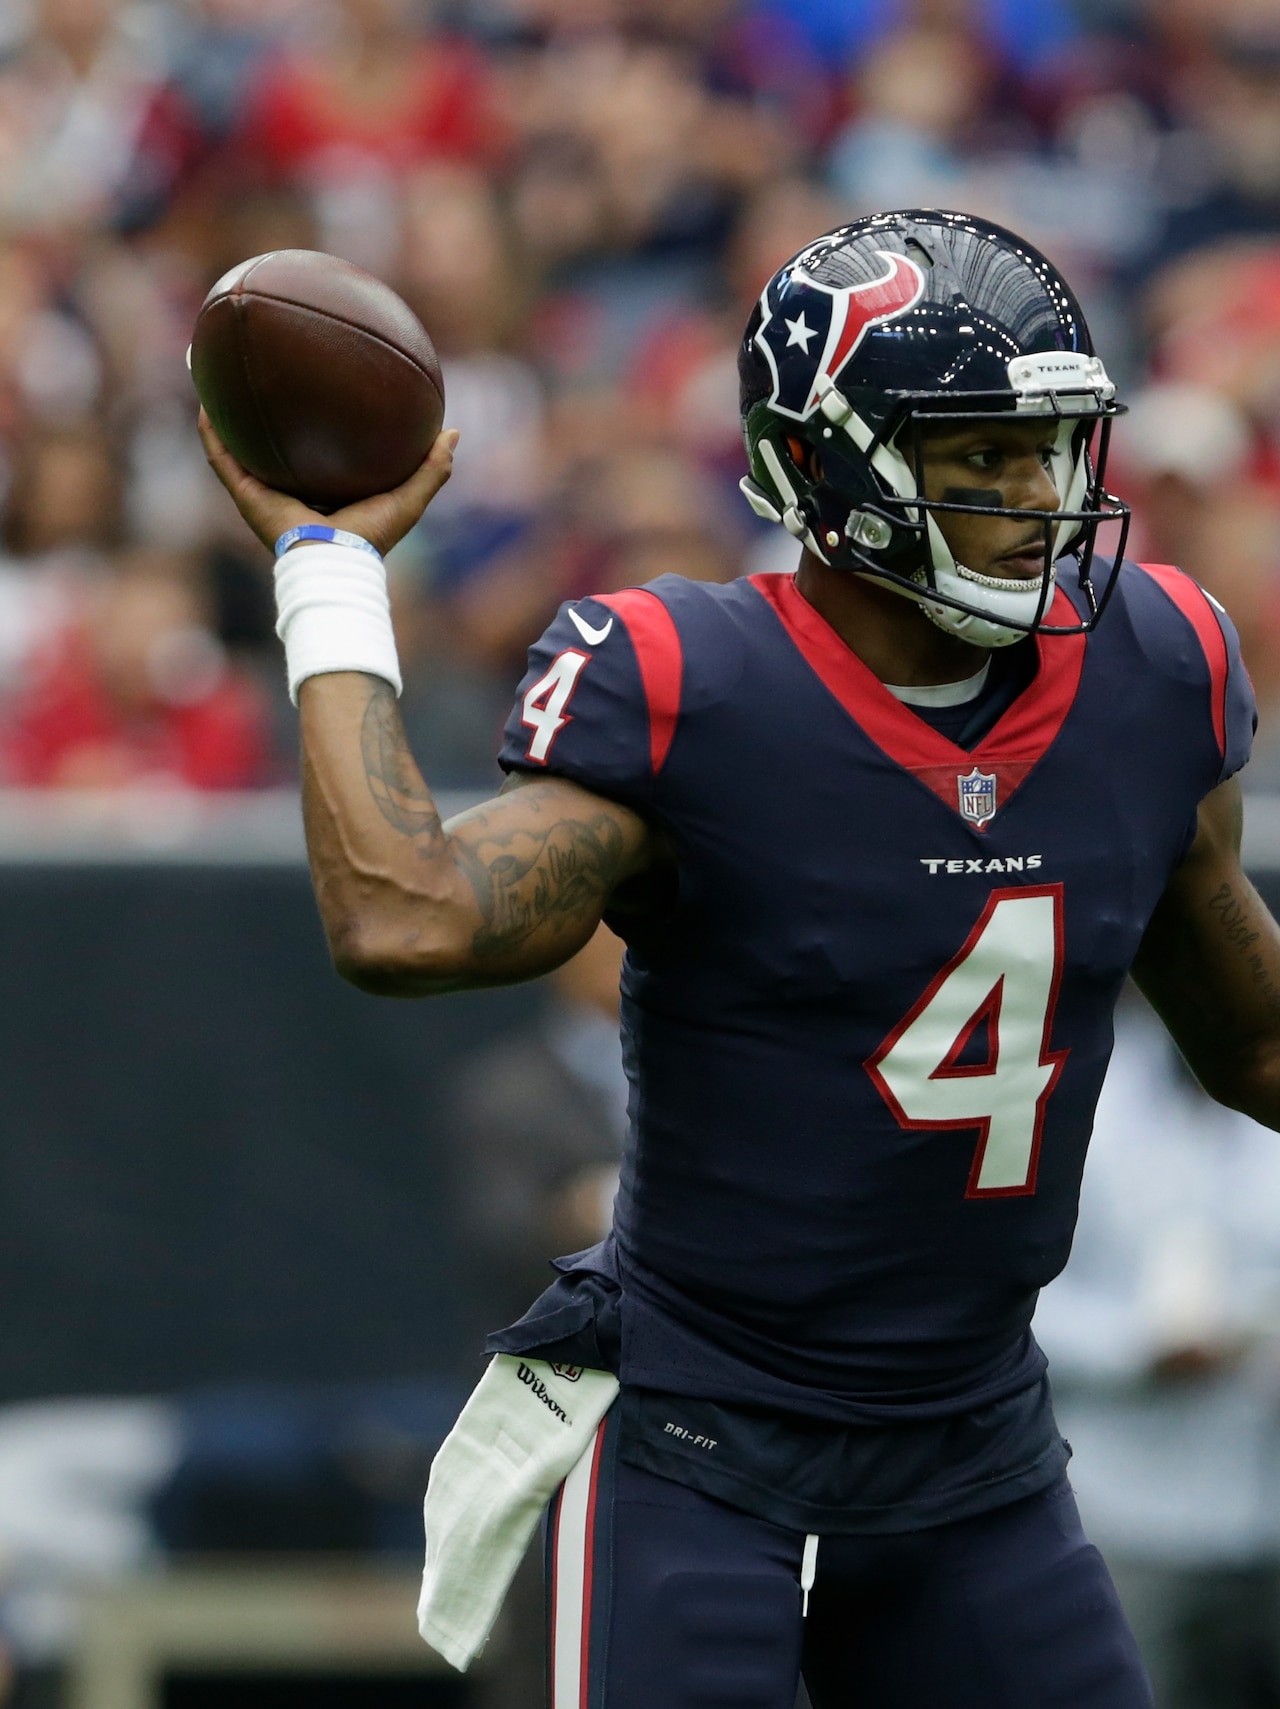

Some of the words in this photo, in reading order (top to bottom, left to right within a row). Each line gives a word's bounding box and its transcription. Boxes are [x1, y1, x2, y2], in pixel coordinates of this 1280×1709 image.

[520, 647, 592, 765] 4
[966, 795, 991, 814] NFL
[920, 854, 1042, 875] TEXANS
[863, 883, 1069, 1199] 4
[516, 1362, 567, 1423] Wilson
[663, 1421, 718, 1450] DRI-FIT
